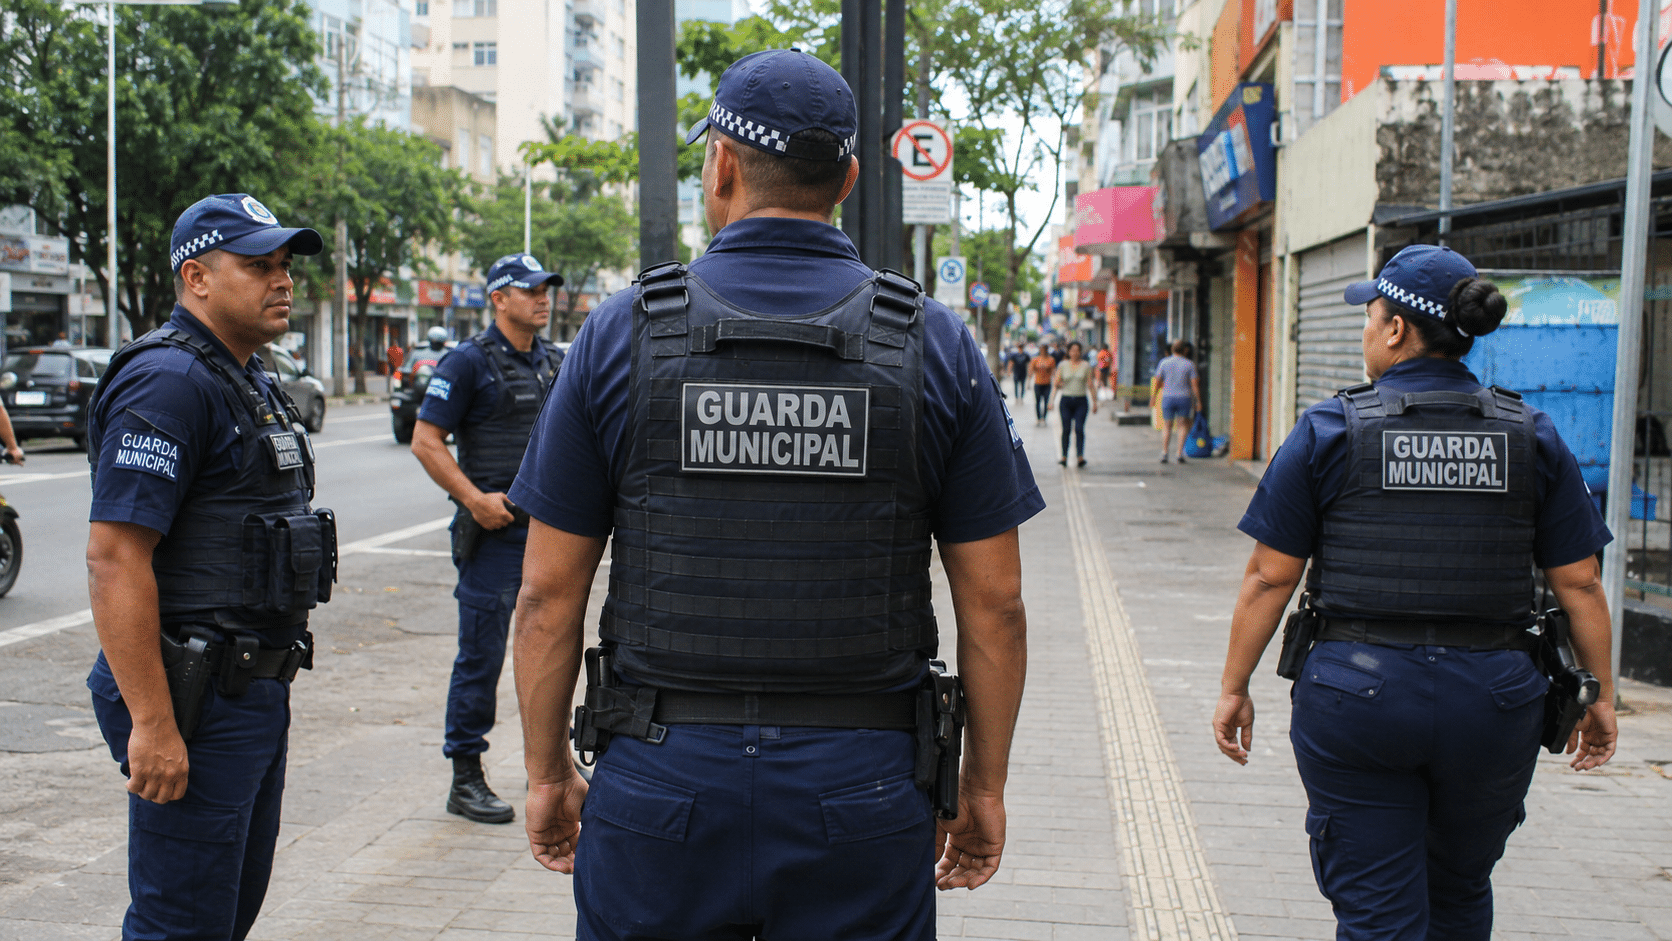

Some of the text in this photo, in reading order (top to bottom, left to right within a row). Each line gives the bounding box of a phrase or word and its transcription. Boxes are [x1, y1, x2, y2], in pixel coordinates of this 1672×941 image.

[696, 390, 852, 429] GUARDA
[121, 432, 178, 460] GUARDA
[690, 429, 859, 468] MUNICIPAL
[1393, 435, 1497, 460] GUARDA
[115, 448, 176, 478] MUNICIPAL
[1388, 461, 1503, 487] MUNICIPAL
